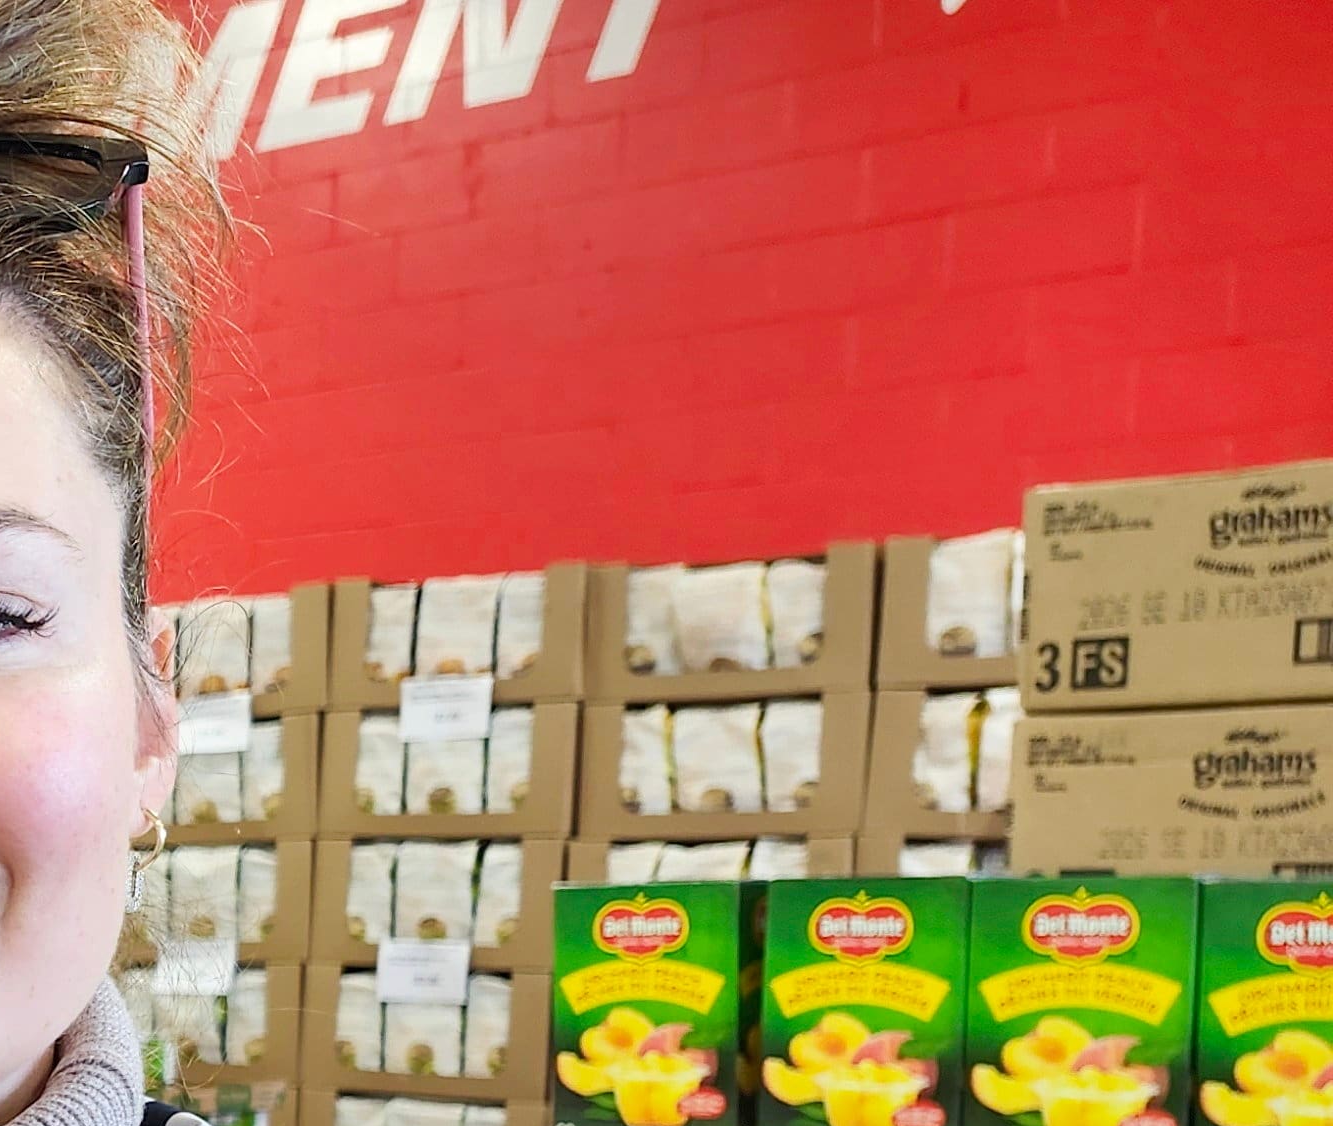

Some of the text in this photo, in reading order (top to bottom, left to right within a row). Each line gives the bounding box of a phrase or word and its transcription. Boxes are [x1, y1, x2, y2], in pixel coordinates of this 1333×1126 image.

[1035, 640, 1126, 693] 3 FS
[1034, 912, 1130, 937] Del Monte
[1270, 919, 1304, 947] Del
